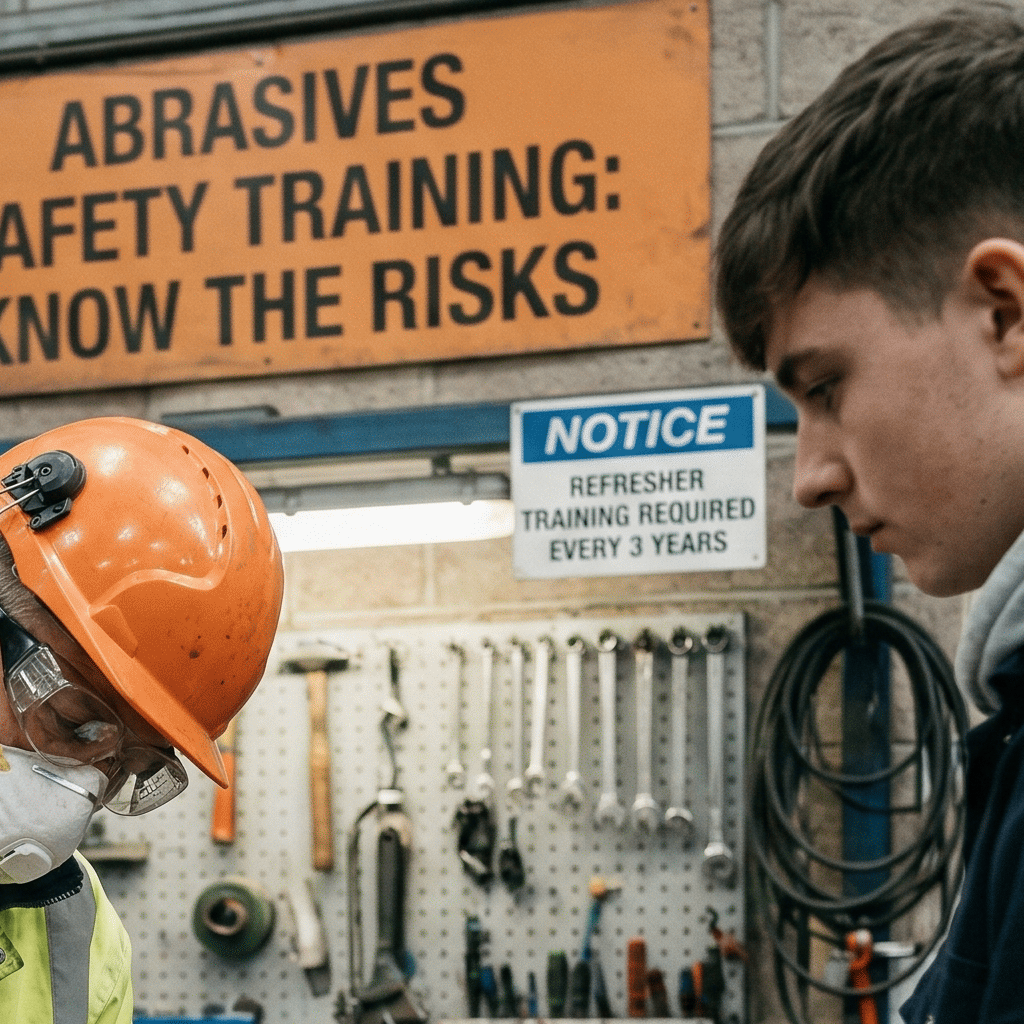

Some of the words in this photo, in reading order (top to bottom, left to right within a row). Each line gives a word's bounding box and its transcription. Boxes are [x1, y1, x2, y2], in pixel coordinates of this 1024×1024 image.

[50, 52, 466, 171] ABRASIVES
[235, 139, 620, 247] TRAINING:
[206, 265, 343, 348] THE
[373, 241, 600, 333] RISKS
[545, 404, 730, 455] NOTICE
[570, 469, 704, 497] REFRESHER
[522, 505, 629, 531] TRAINING
[639, 497, 755, 526] REQUIRED
[550, 535, 621, 561] EVERY
[630, 535, 643, 557] 3
[651, 530, 727, 556] YEARS
